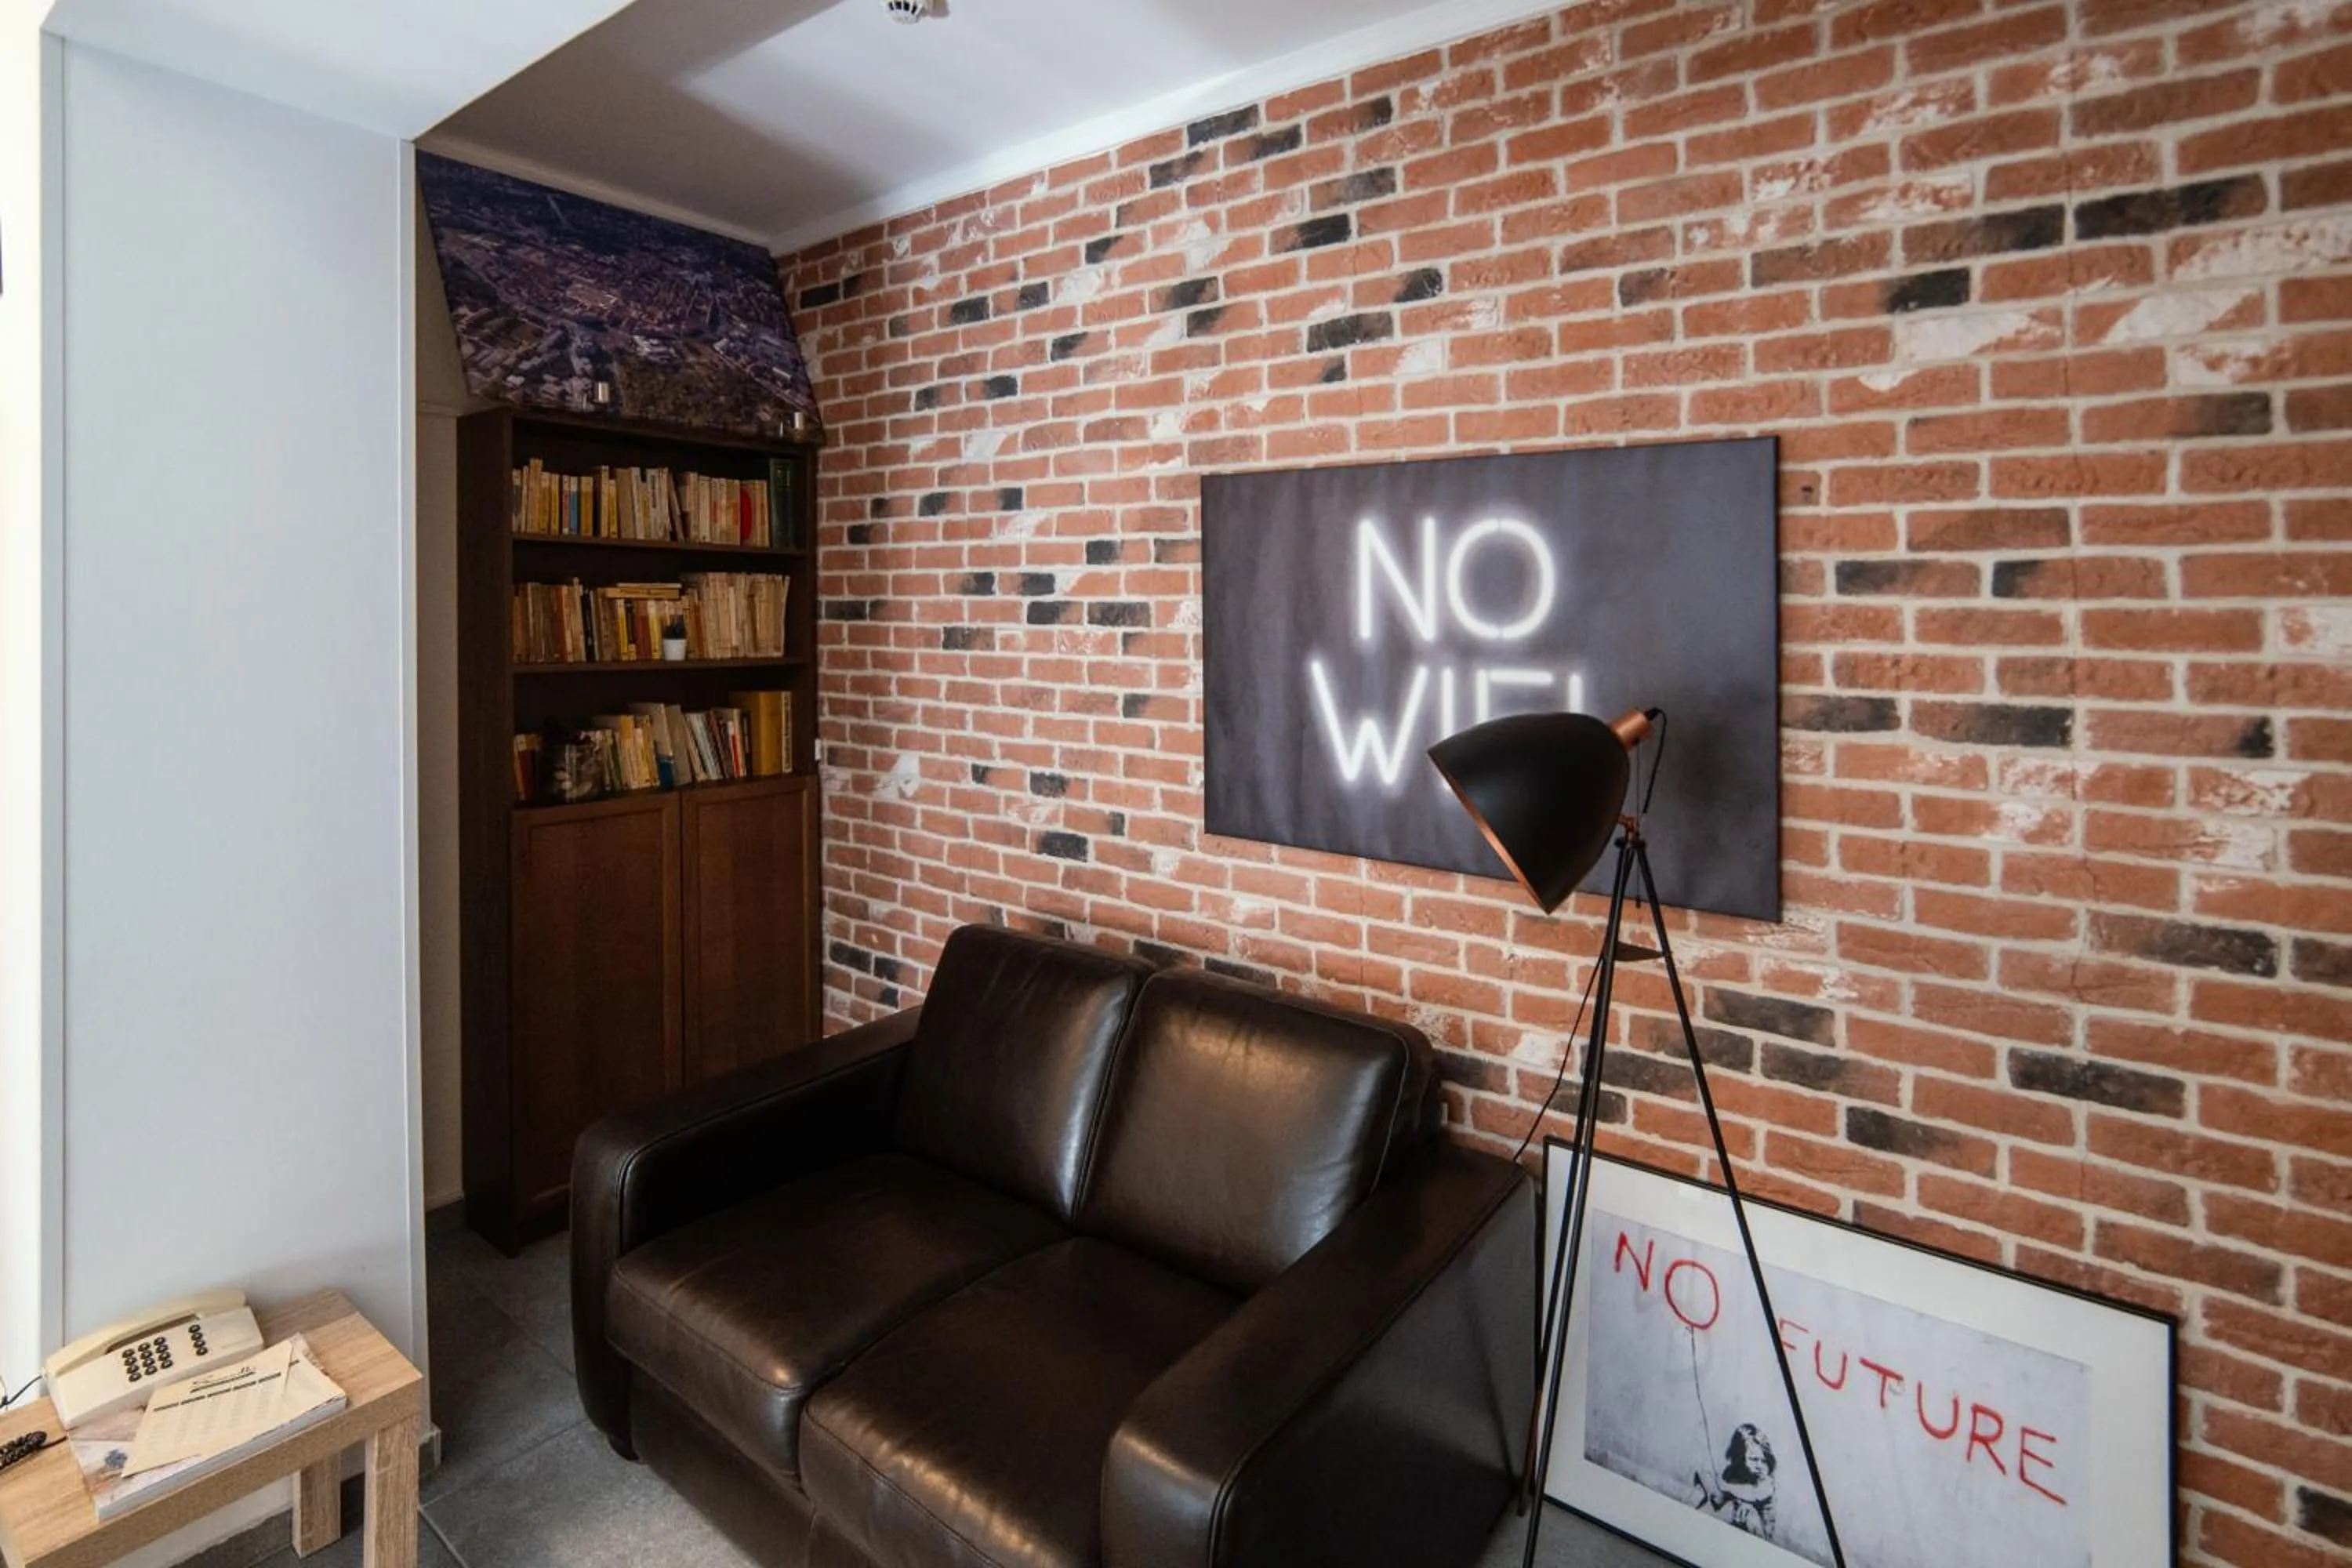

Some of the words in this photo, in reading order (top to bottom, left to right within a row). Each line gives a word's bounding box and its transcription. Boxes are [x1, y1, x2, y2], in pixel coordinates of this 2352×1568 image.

[1356, 515, 1555, 644] NO
[1613, 1231, 1720, 1331] NO
[1778, 1317, 2068, 1506] FUTURE
